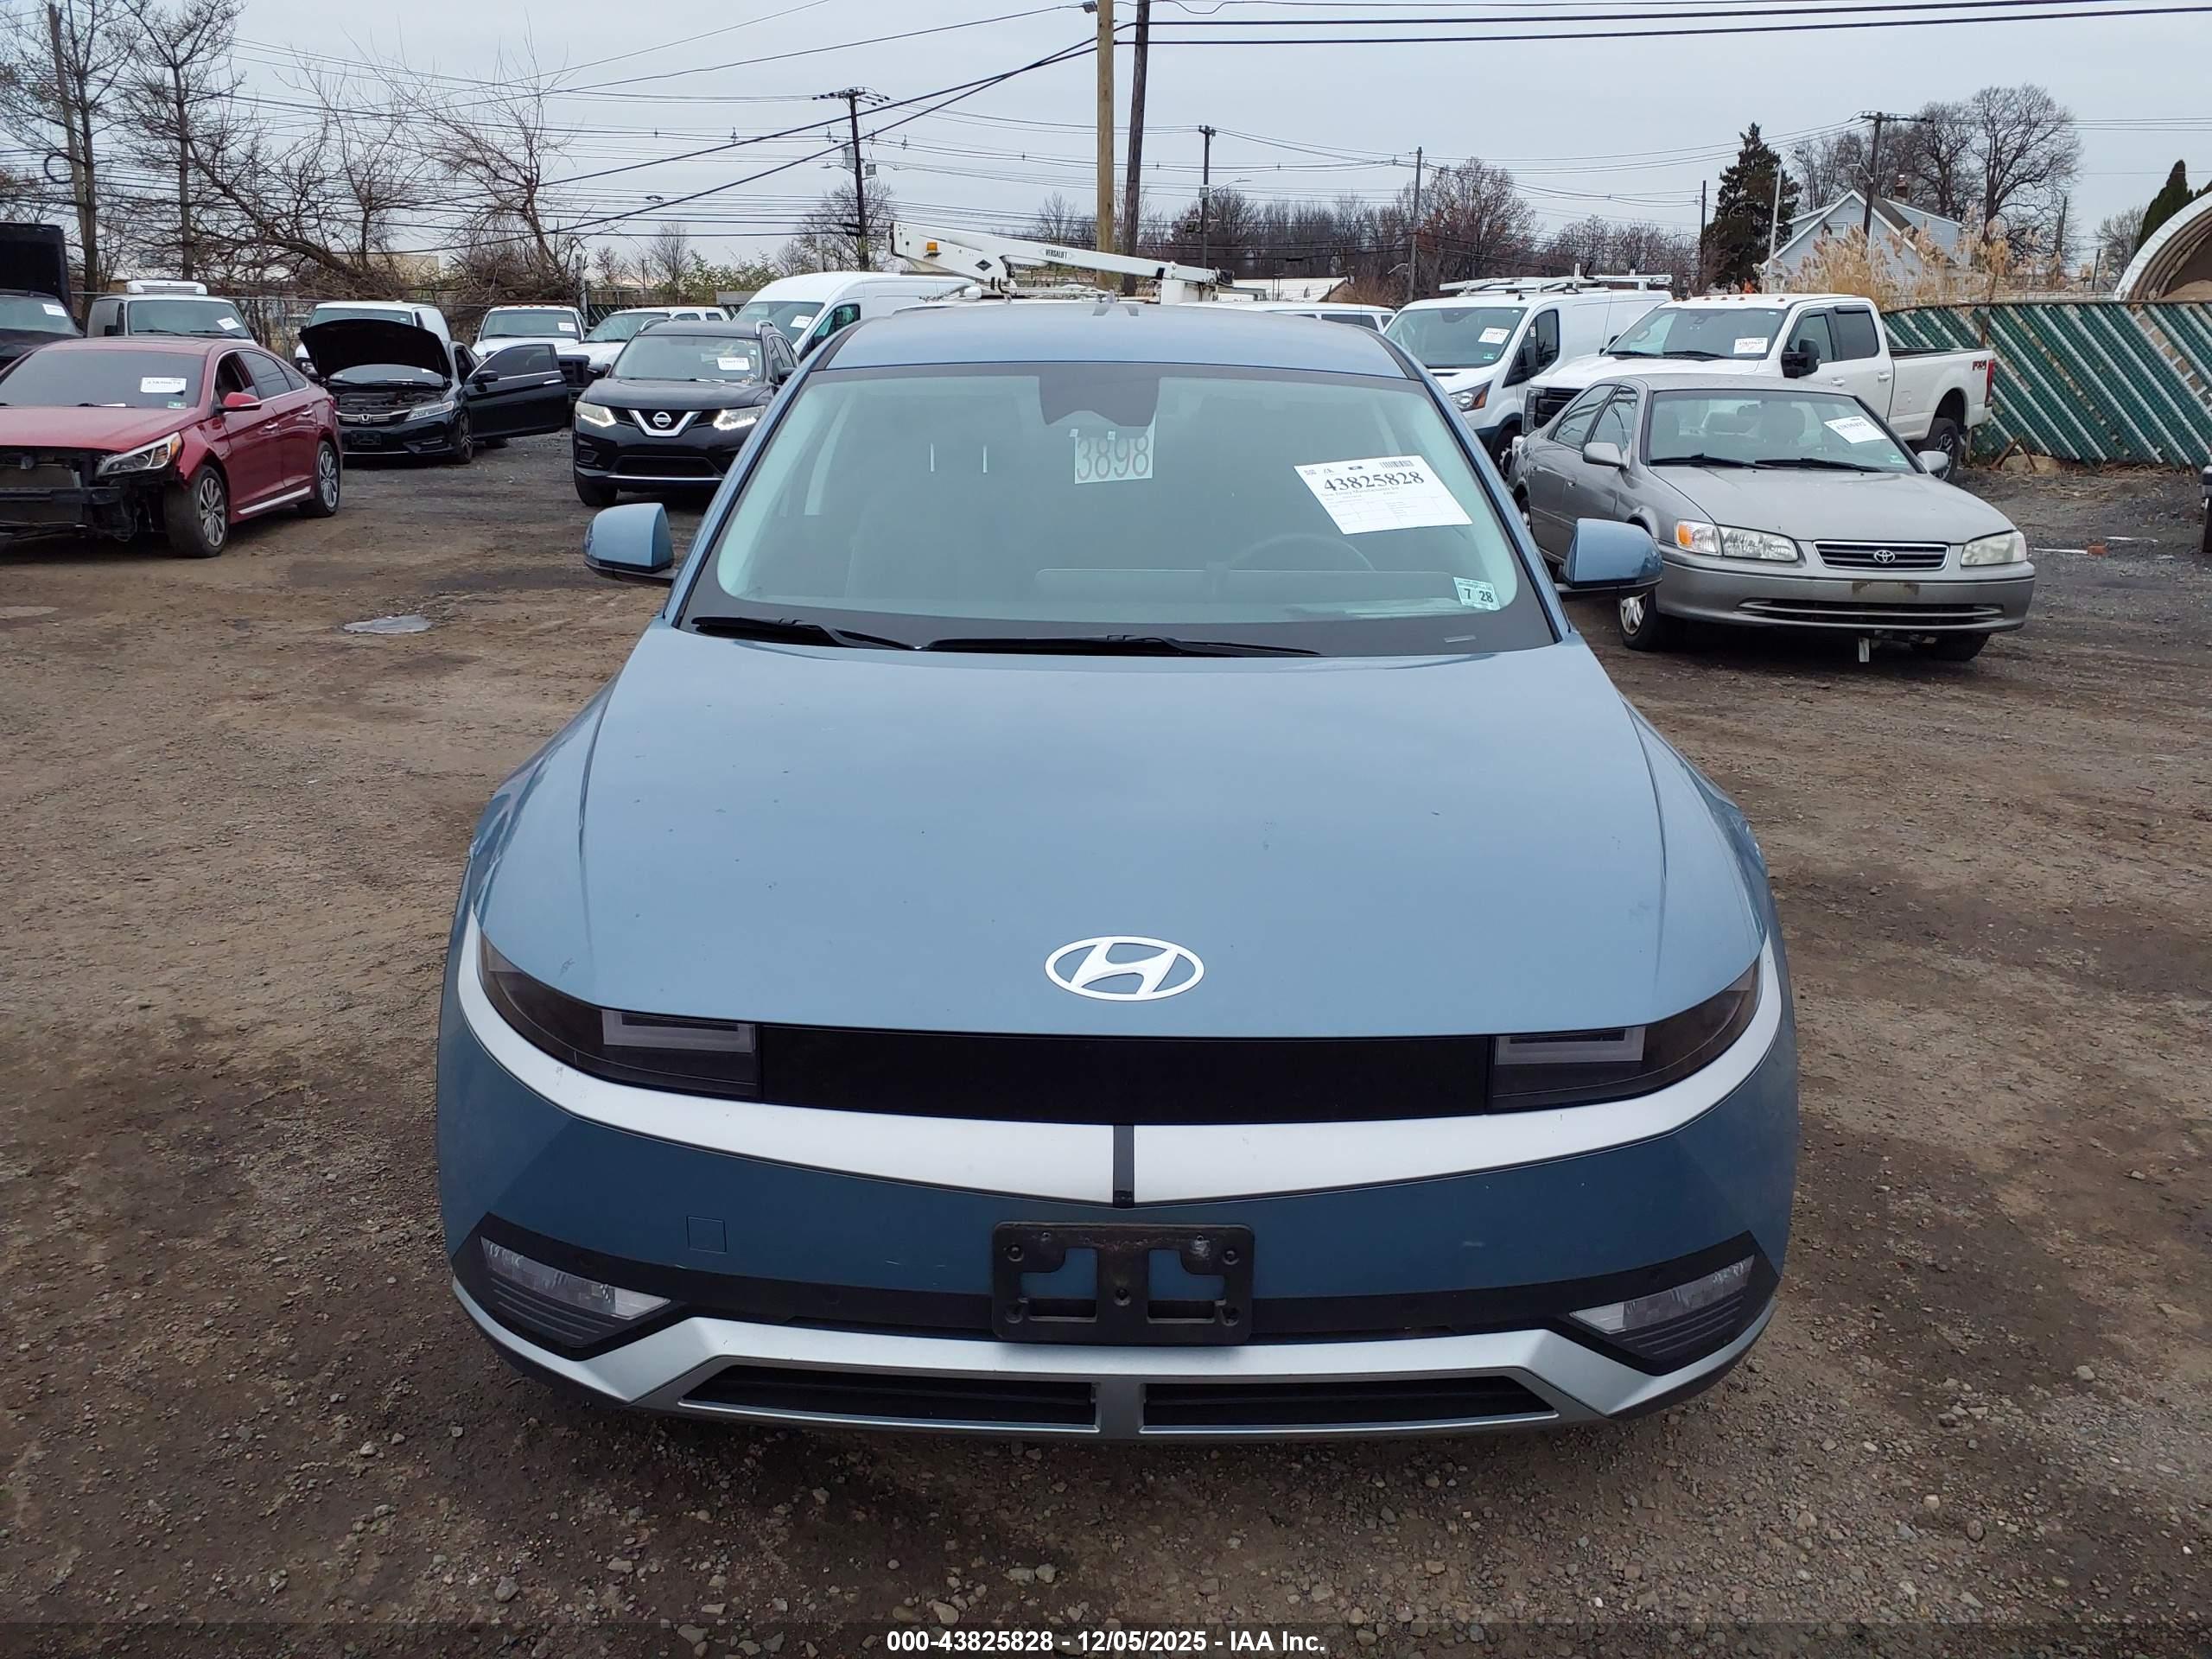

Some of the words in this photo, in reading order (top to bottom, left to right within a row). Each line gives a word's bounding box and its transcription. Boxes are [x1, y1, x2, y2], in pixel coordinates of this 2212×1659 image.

[1046, 249, 1068, 259] VERSALIFT
[1077, 435, 1149, 480] 3898
[1324, 471, 1425, 491] 43825828
[1464, 588, 1471, 600] 7
[1478, 590, 1494, 603] 28
